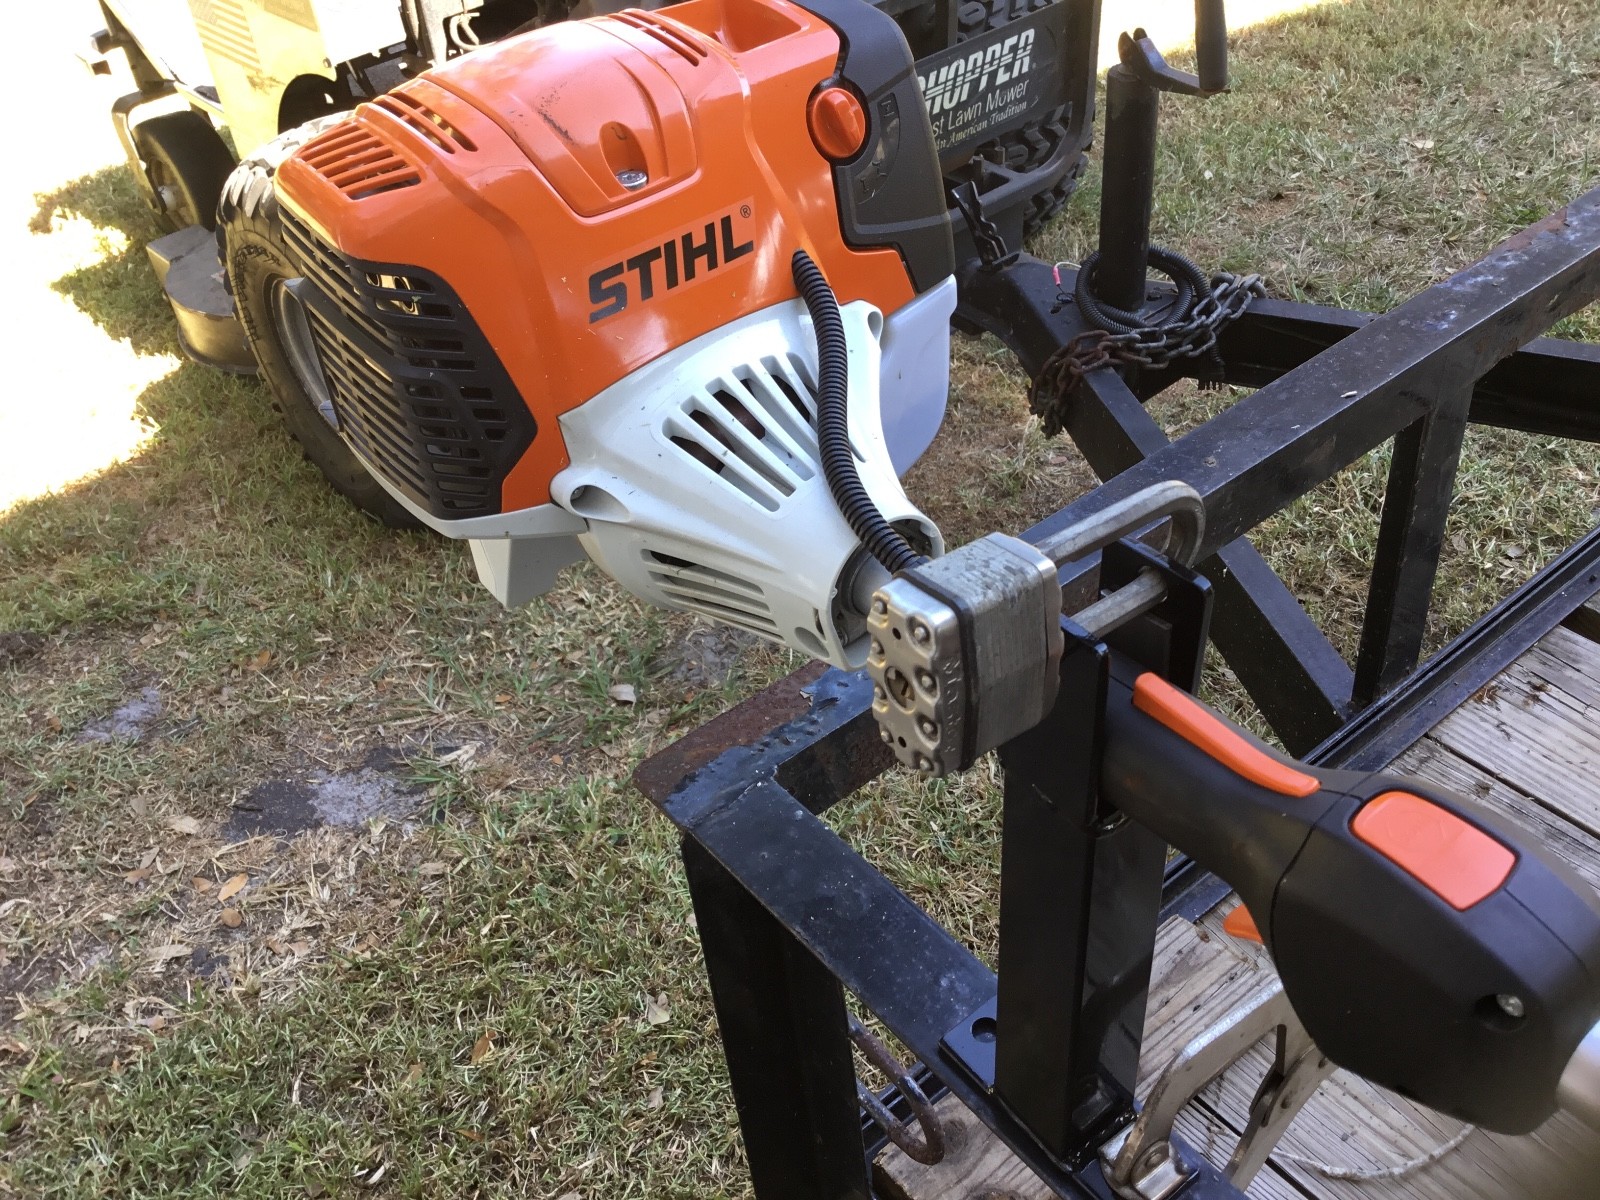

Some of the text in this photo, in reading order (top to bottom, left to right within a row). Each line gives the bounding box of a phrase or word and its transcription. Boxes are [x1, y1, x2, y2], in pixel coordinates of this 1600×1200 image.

[946, 119, 988, 148] American
[989, 100, 1027, 125] Tradition
[948, 102, 982, 131] Lawn
[985, 79, 1030, 113] Mower
[588, 214, 754, 325] STIHL
